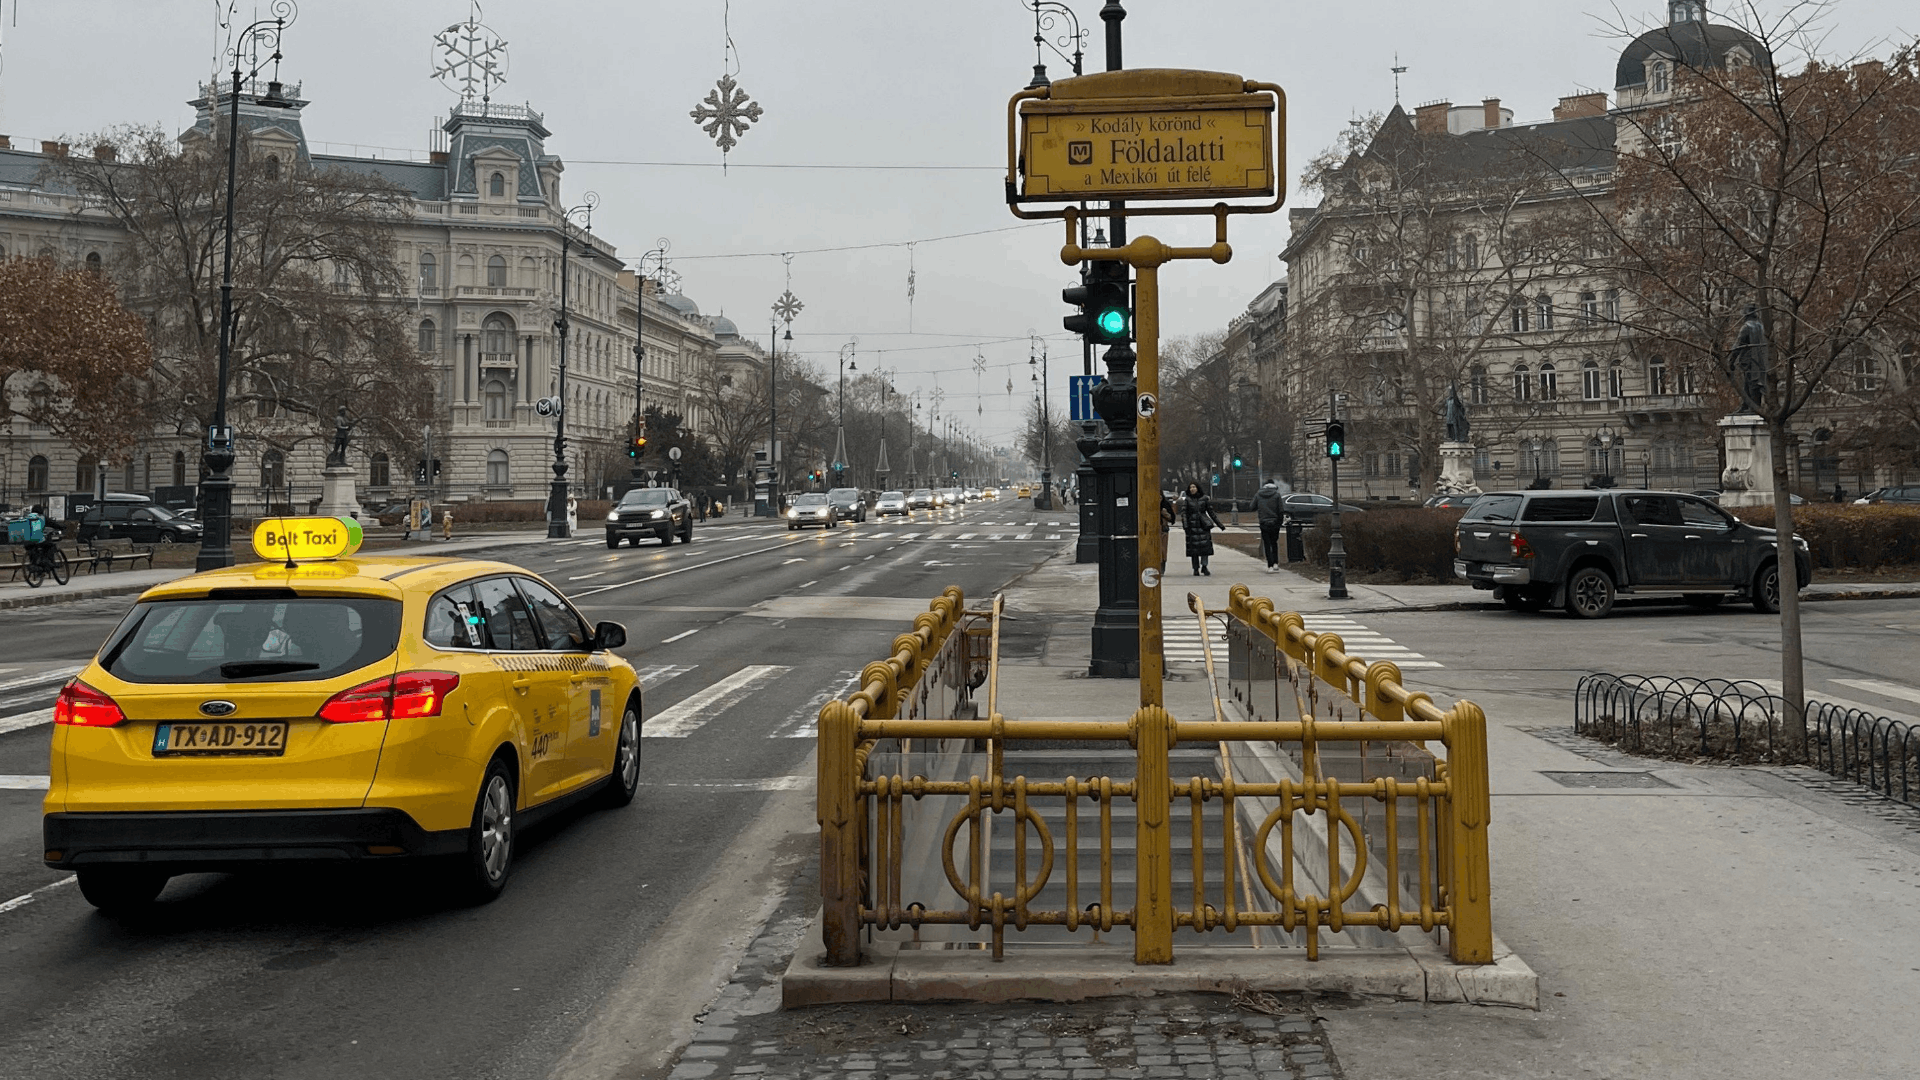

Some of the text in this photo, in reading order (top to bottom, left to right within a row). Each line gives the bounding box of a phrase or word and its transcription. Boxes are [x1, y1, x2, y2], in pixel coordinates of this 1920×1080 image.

[1091, 117, 1143, 136] Kodály
[1149, 115, 1202, 132] körönd
[1073, 145, 1087, 156] M
[1110, 136, 1225, 164] Földalatti
[1084, 165, 1211, 185] a Mexikói út felé
[266, 529, 337, 547] Bolt Taxi
[157, 725, 282, 747] H TX AD-912
